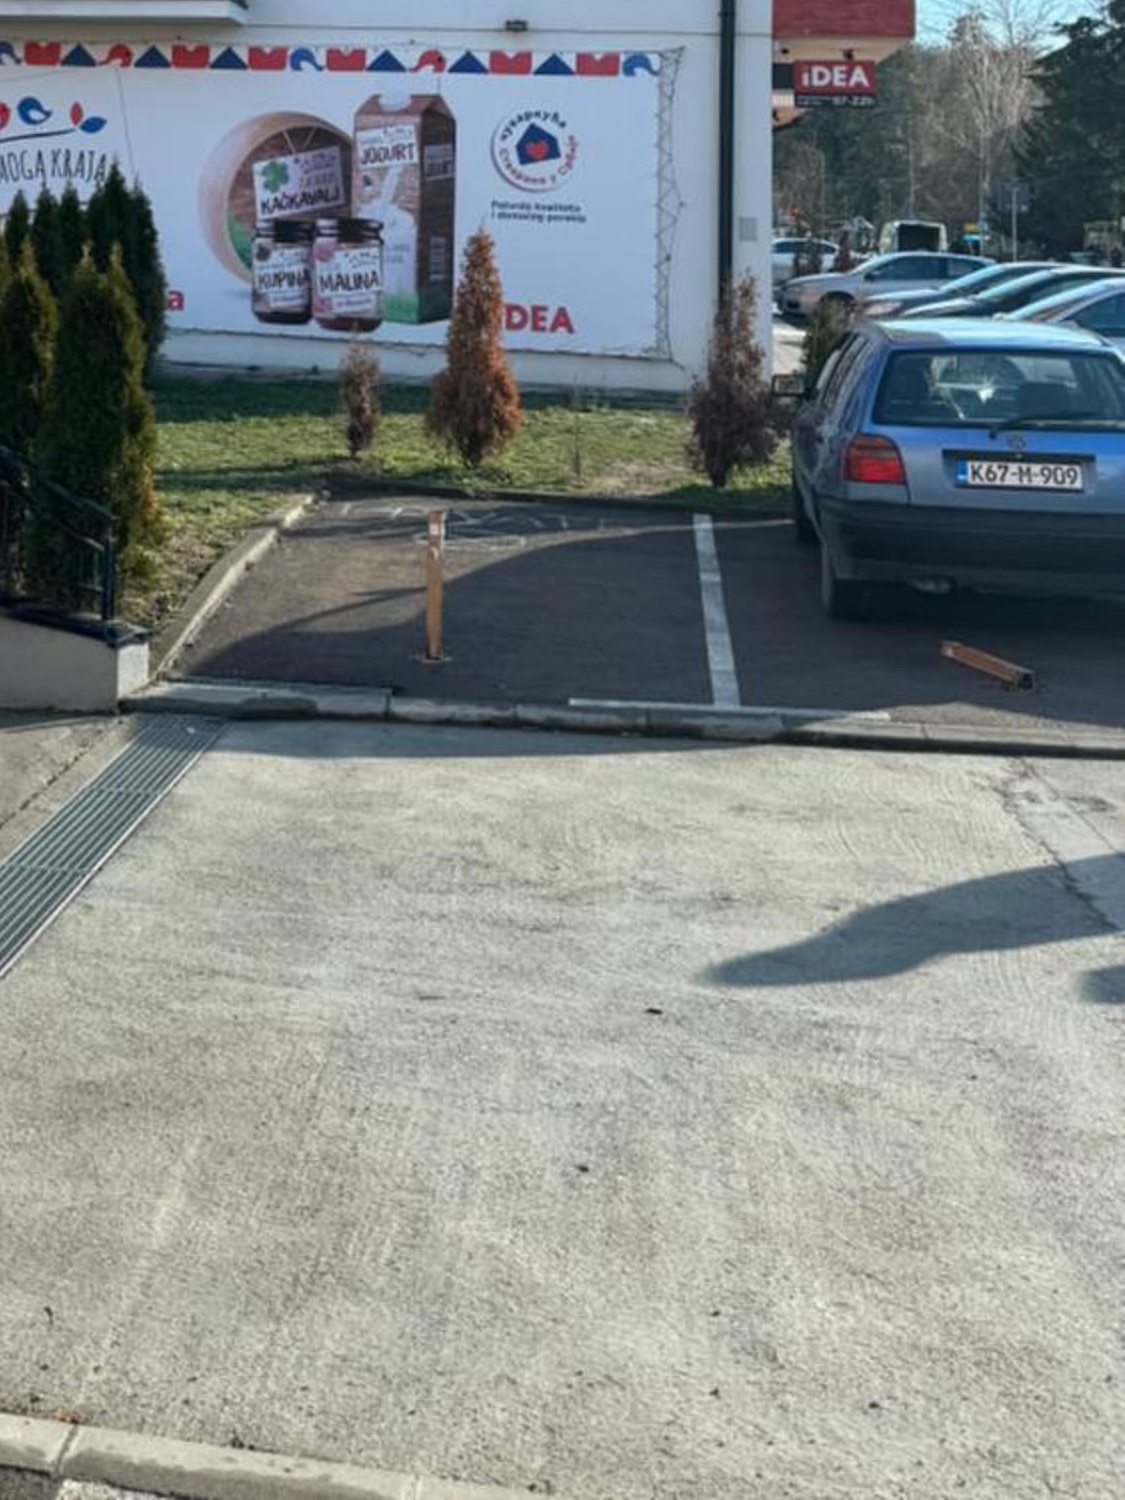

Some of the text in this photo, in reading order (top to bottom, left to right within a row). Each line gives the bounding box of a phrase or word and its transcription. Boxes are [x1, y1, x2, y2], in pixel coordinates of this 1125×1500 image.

[51, 148, 108, 183] KRAJA
[319, 269, 380, 294] MALINA
[505, 304, 575, 334] DEA
[970, 463, 1079, 485] K67-M-909
